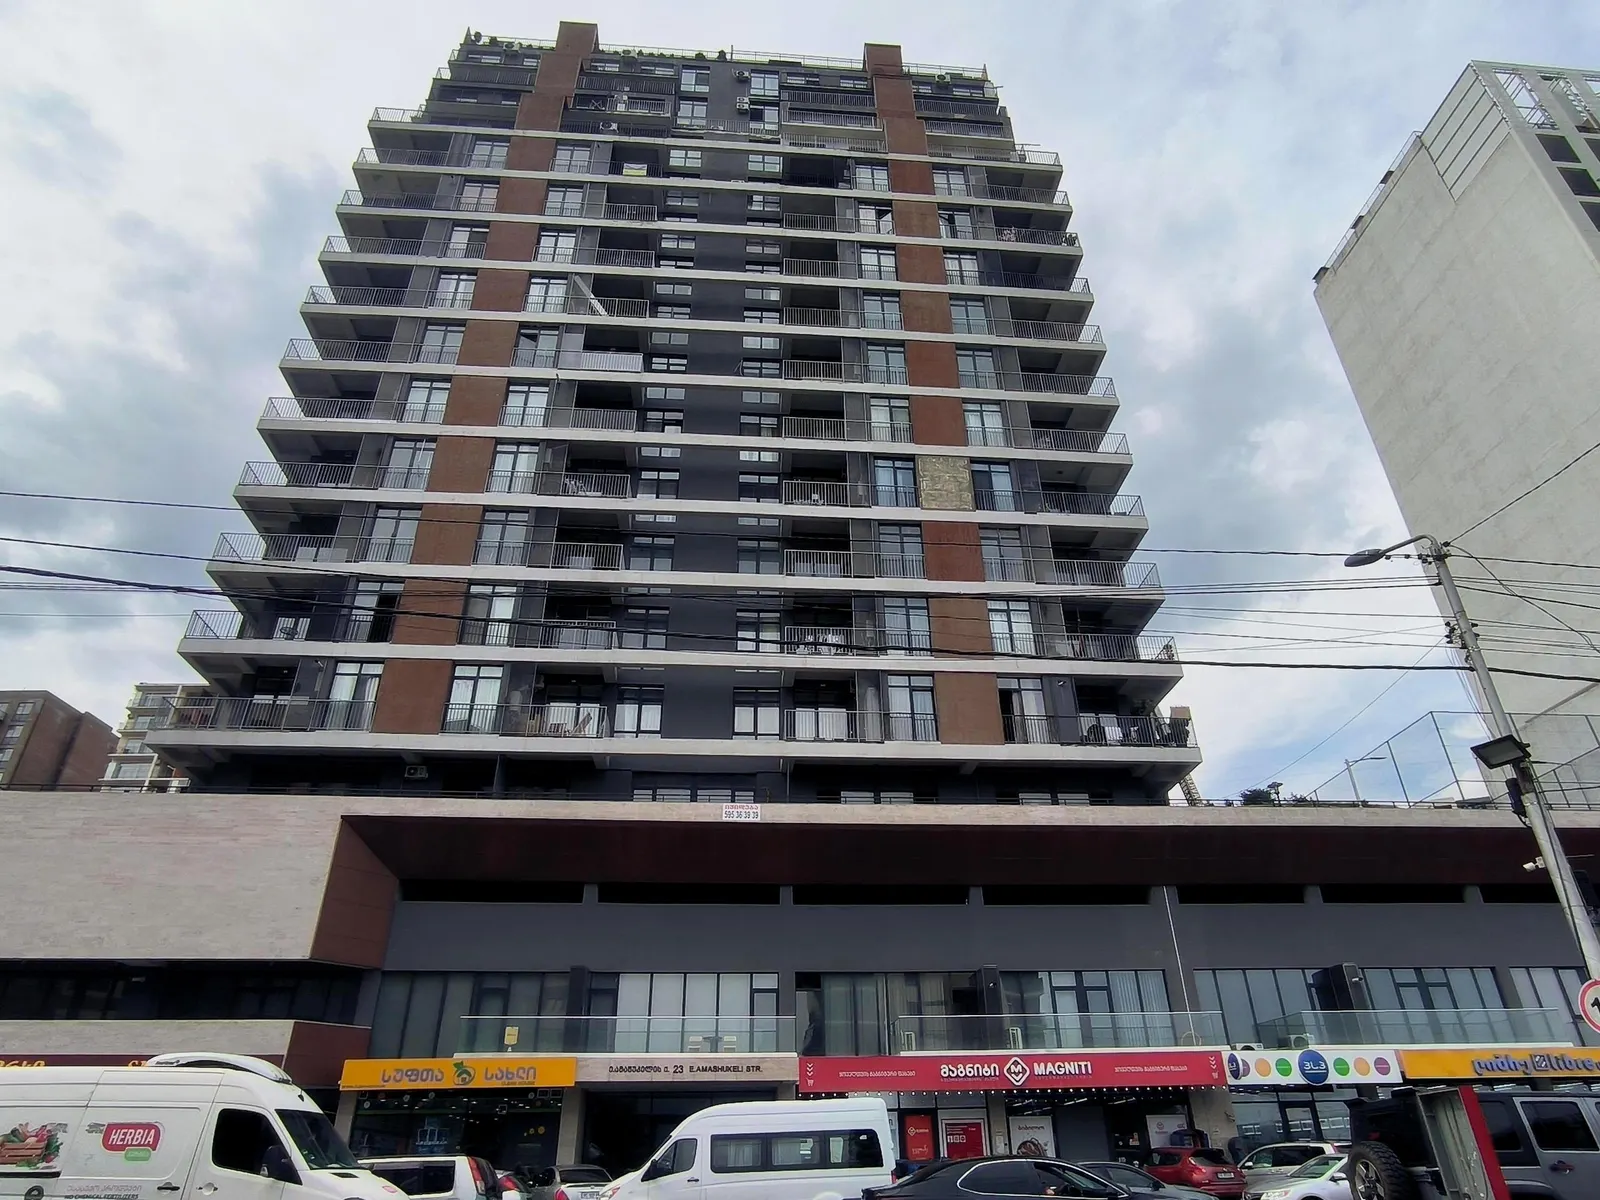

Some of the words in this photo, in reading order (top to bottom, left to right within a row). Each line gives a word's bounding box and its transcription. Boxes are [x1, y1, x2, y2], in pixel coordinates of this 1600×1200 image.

[724, 810, 735, 819] 595
[752, 811, 759, 819] 39
[746, 1065, 763, 1073] STR.
[1033, 1061, 1092, 1076] MAGNITI
[1548, 1053, 1594, 1071] libre
[381, 1068, 444, 1083] სუფთა
[484, 1066, 537, 1081] სახლი
[673, 1065, 684, 1074] 23
[940, 1063, 1000, 1077] მაგნიტი
[108, 1128, 156, 1145] HERBIA
